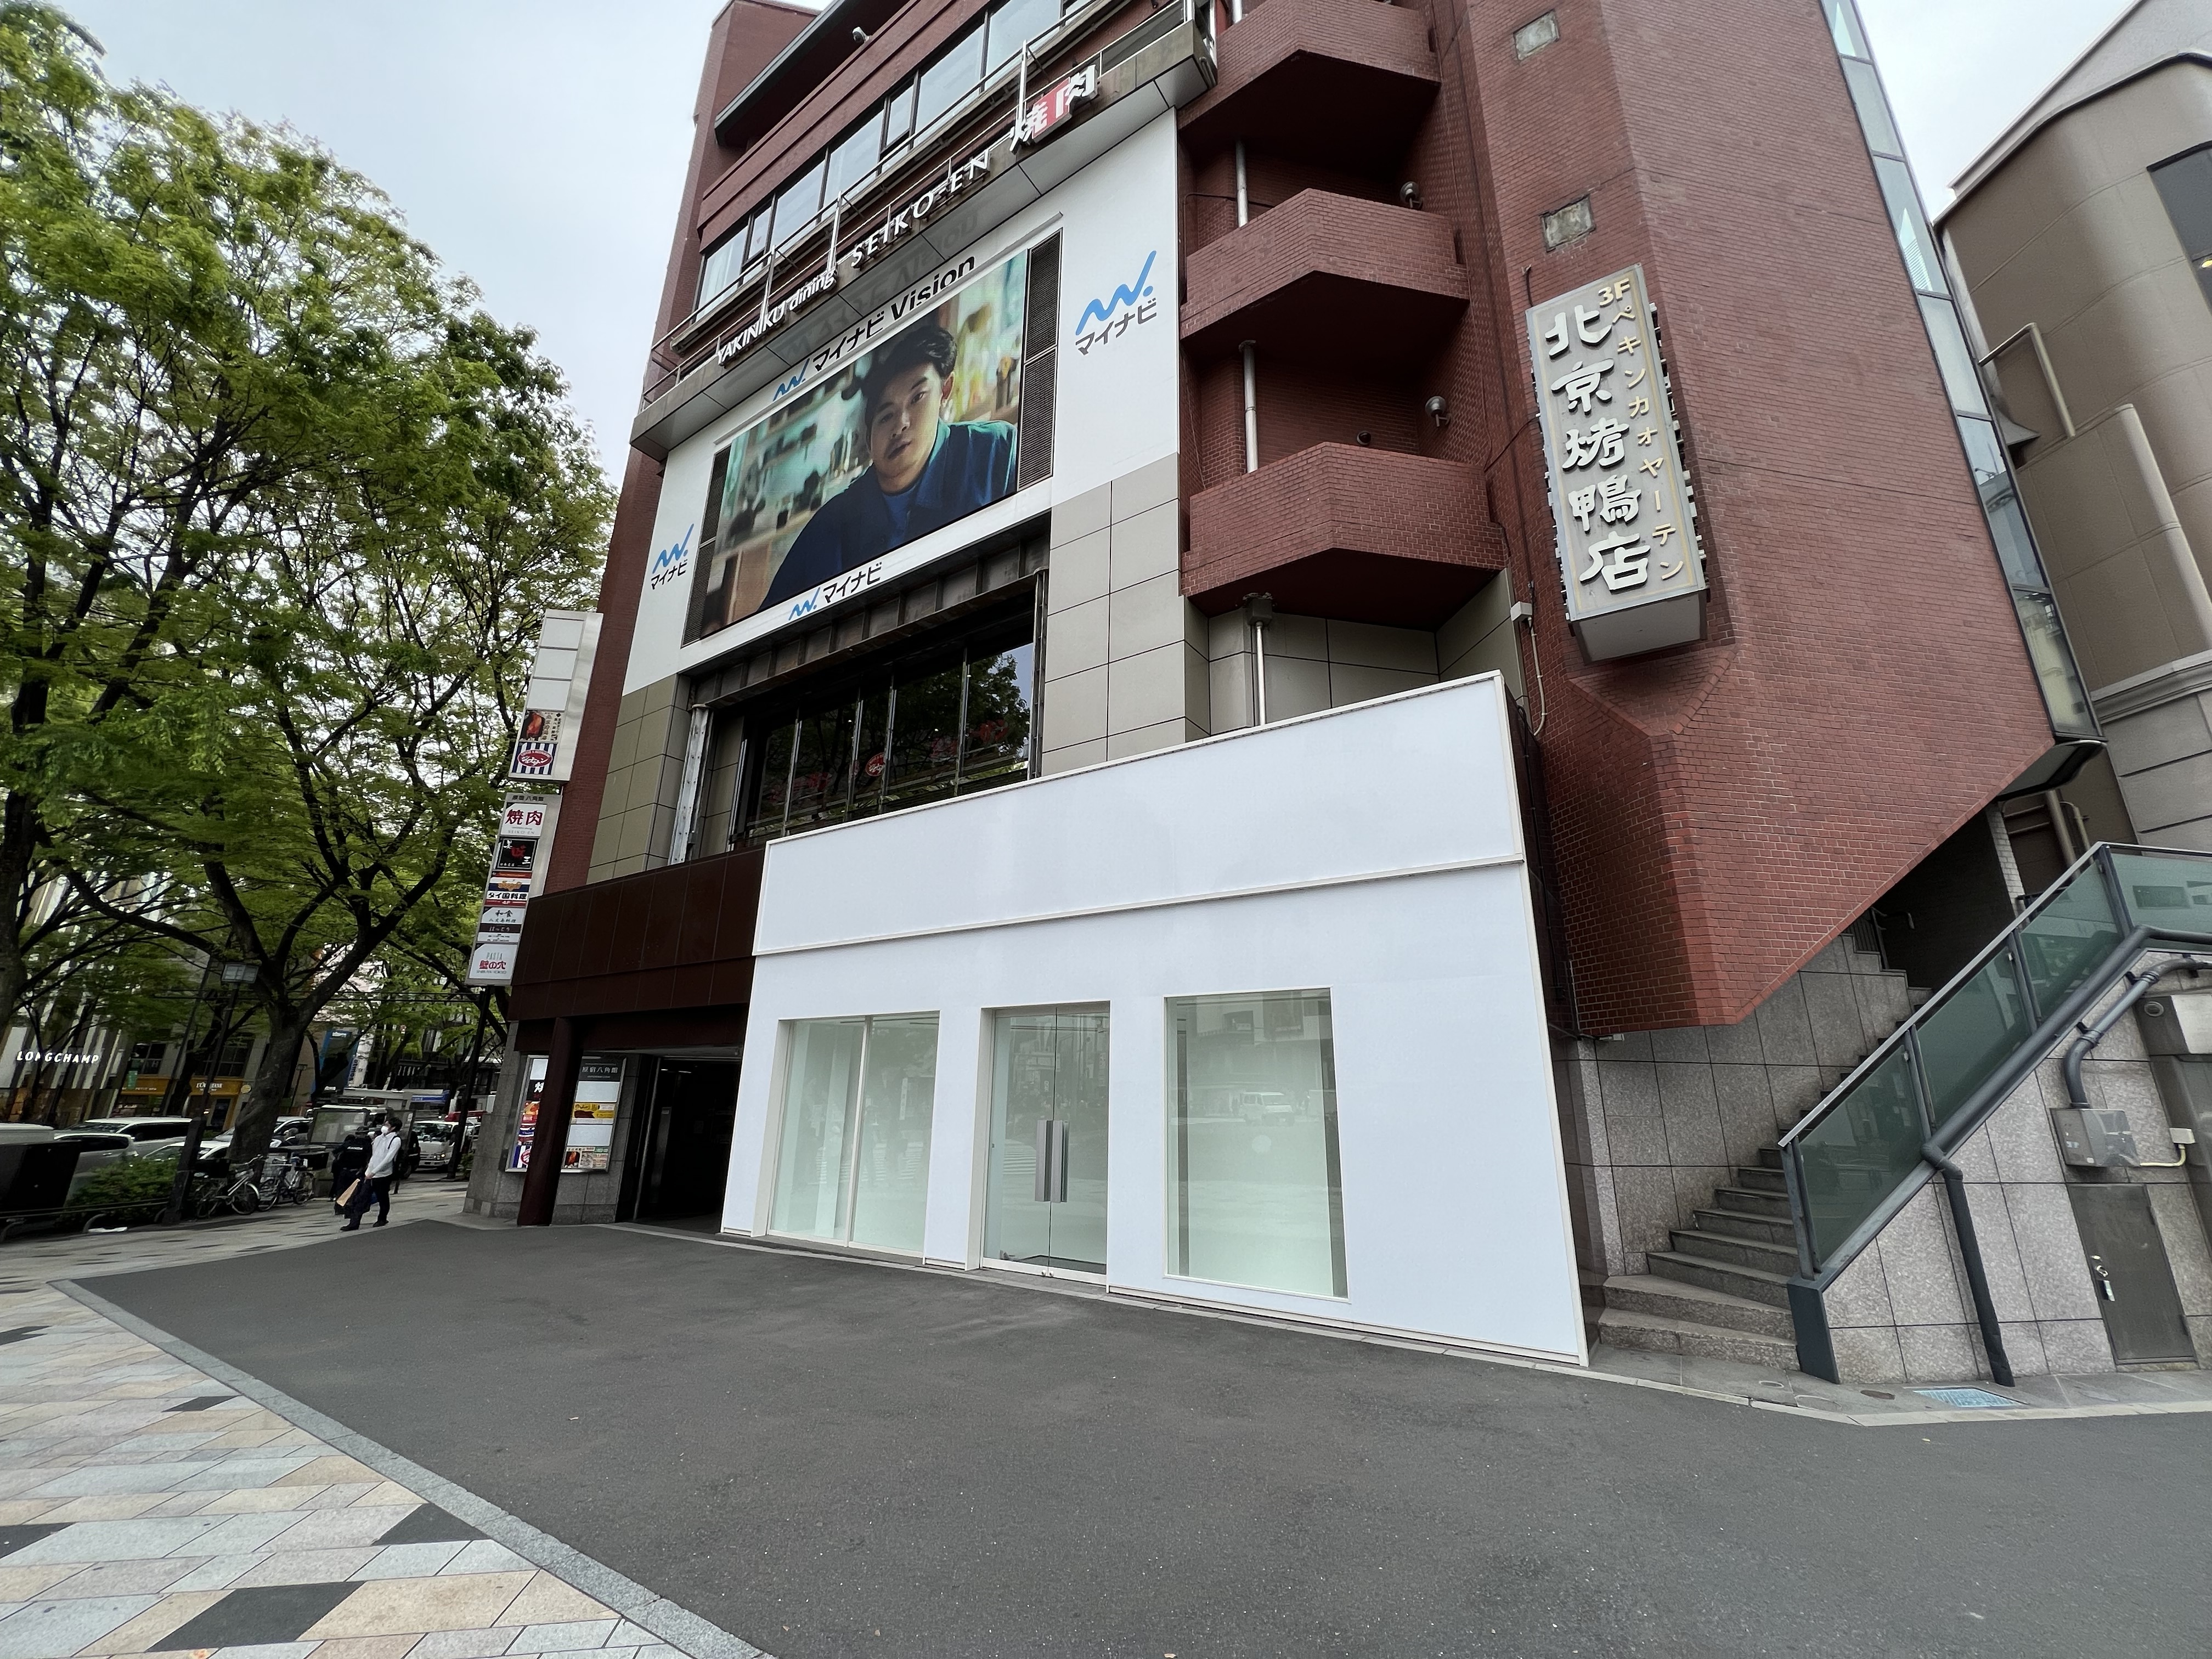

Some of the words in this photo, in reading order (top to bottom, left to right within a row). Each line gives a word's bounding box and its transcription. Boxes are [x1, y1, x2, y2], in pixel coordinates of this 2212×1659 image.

[1009, 64, 1097, 154] 焼肉
[789, 268, 837, 312] dining
[1598, 277, 1631, 308] 3F
[812, 311, 885, 372] マイナビ
[890, 256, 976, 321] Vision
[1075, 297, 1157, 356] マイナビ
[1545, 303, 1651, 592] 北京烤鴨店
[651, 558, 688, 590] マイナビ
[823, 562, 882, 603] マイナビ
[505, 809, 543, 826] 焼肉
[495, 910, 513, 918] 和食
[479, 960, 506, 969] 壁の穴
[486, 952, 503, 961] PASTA
